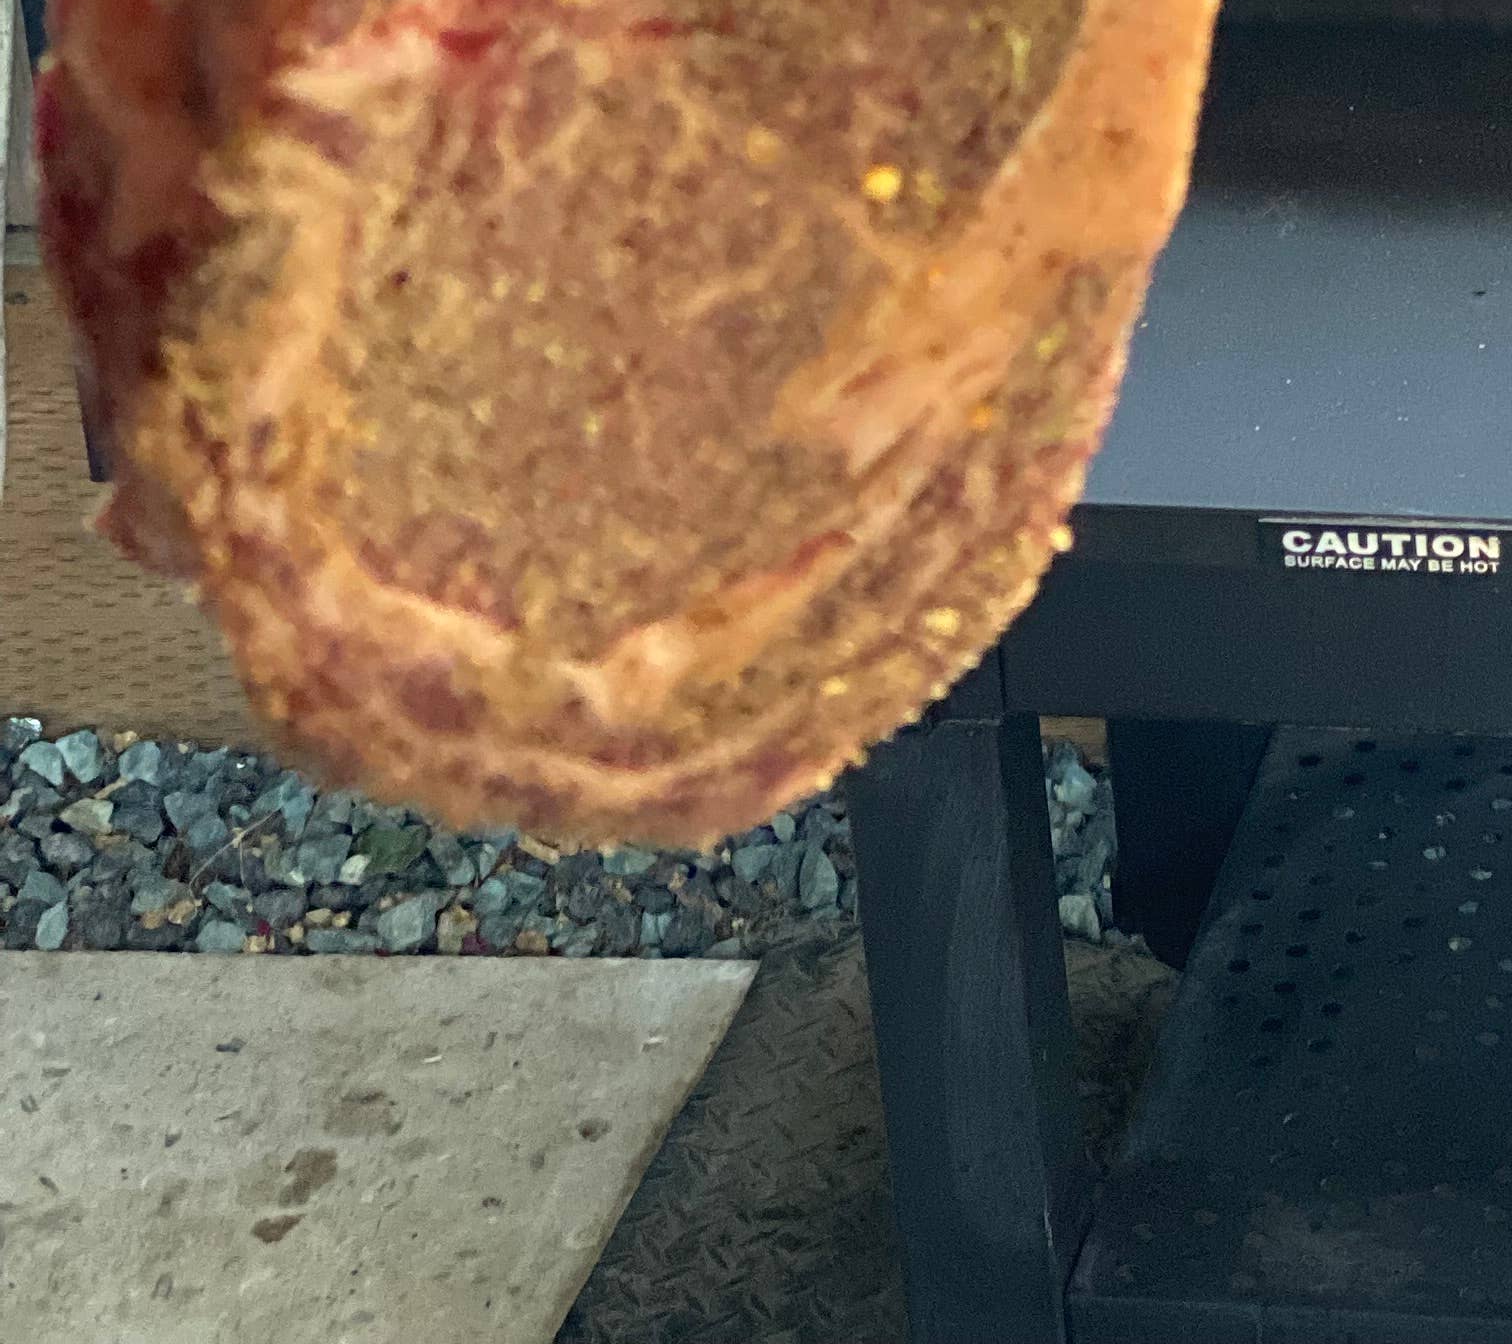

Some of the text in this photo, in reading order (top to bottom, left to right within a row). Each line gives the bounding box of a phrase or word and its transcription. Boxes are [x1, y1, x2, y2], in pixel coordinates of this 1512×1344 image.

[1281, 529, 1501, 559] CAUTION
[1284, 554, 1500, 574] SURFACE MAY BE HOT
